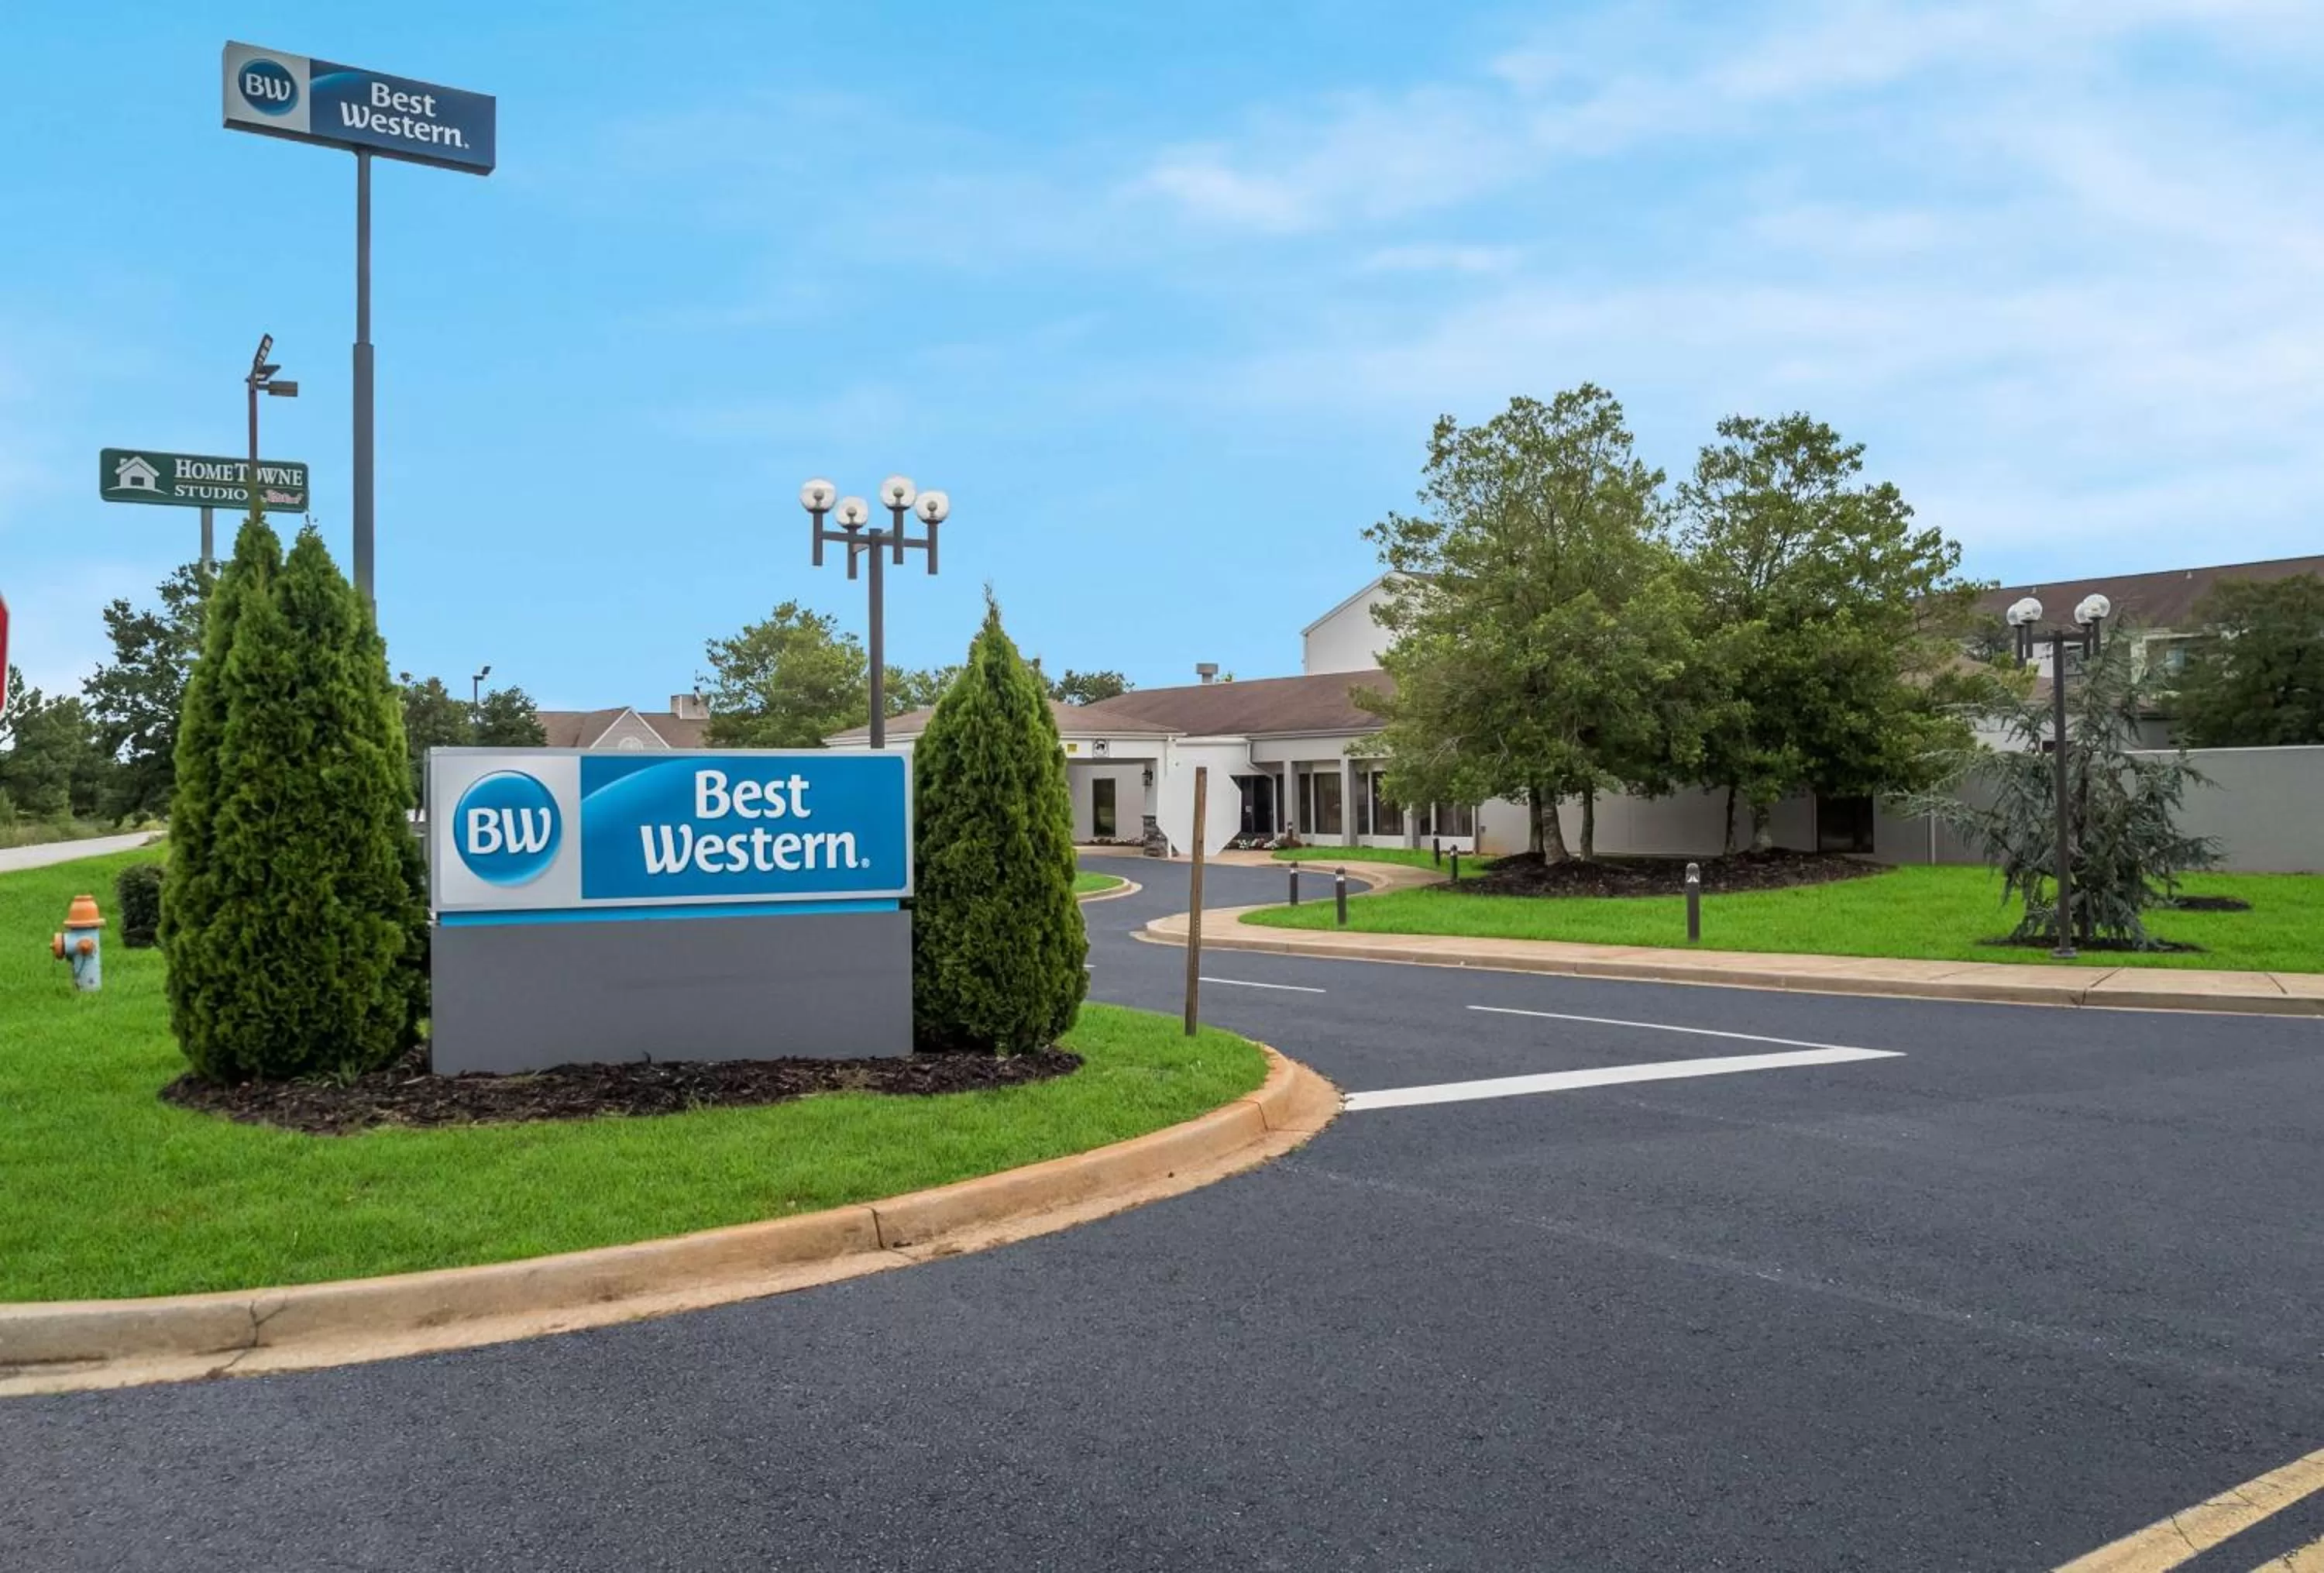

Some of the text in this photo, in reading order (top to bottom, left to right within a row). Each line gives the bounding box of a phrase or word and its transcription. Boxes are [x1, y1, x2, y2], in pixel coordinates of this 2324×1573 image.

[246, 74, 290, 101] BW
[371, 81, 436, 117] Best
[174, 484, 249, 501] STUDIO
[696, 769, 811, 819] Best
[467, 807, 552, 855] BW
